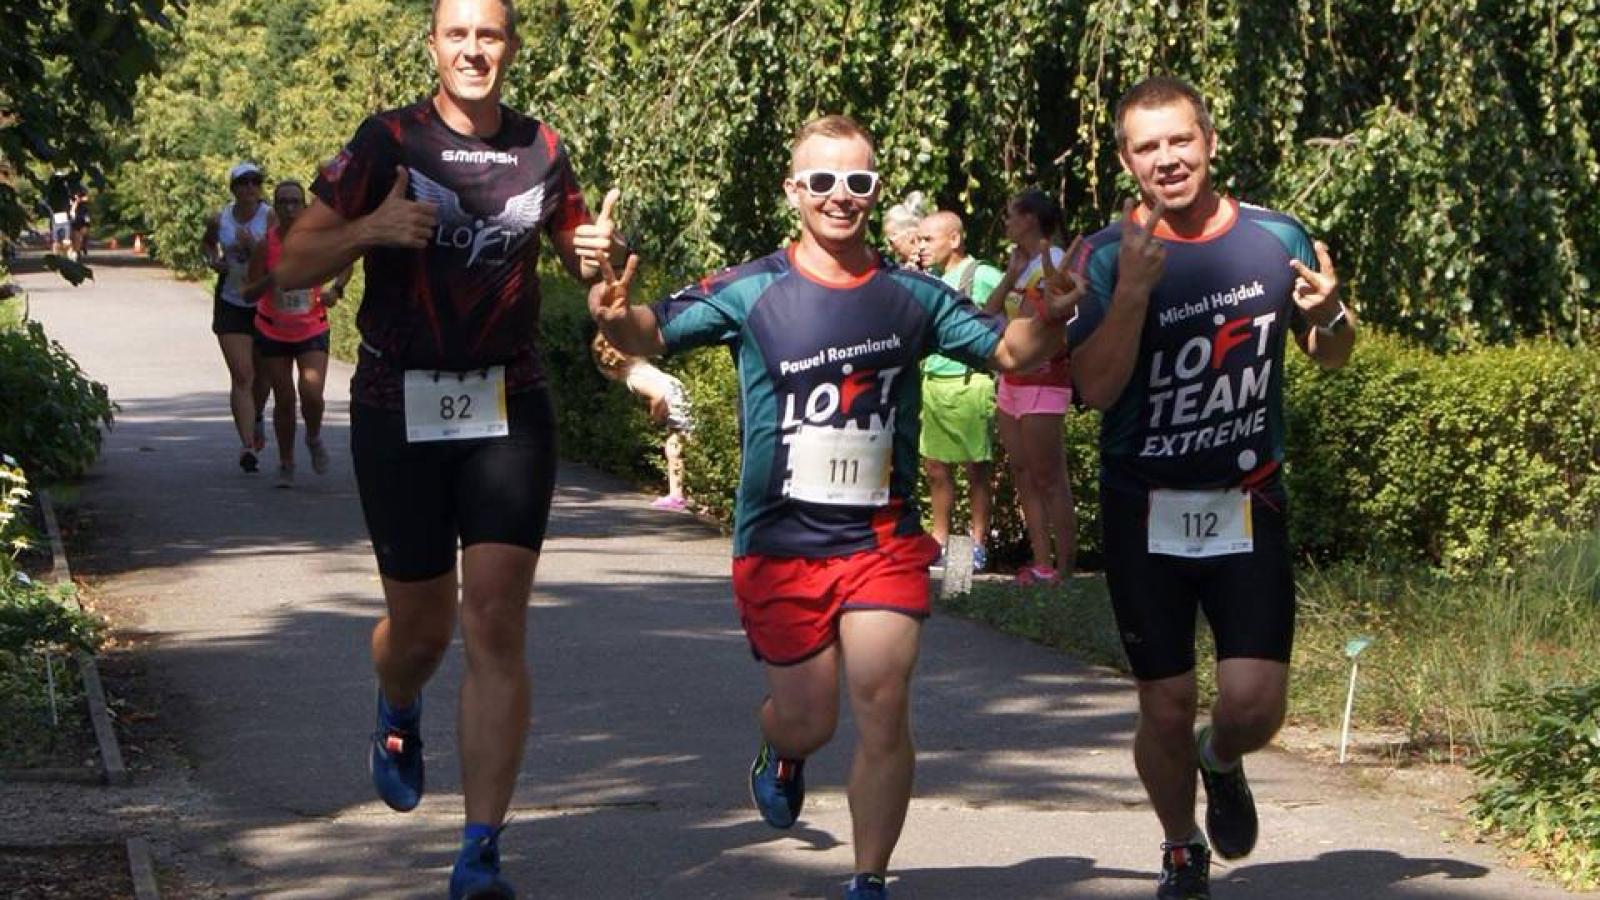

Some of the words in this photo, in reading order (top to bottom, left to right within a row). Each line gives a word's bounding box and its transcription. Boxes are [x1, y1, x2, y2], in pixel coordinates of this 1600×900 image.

[440, 150, 519, 165] SMMASH
[436, 219, 518, 268] LOFT
[1211, 281, 1265, 309] Hajduk
[827, 333, 901, 362] Rozmiarek
[1149, 311, 1277, 388] LOFT
[440, 394, 473, 420] 82
[782, 363, 903, 430] LOFT
[1149, 360, 1272, 428] TEAM
[1140, 408, 1266, 456] EXTREME
[830, 459, 859, 484] 111
[1182, 511, 1219, 538] 112
